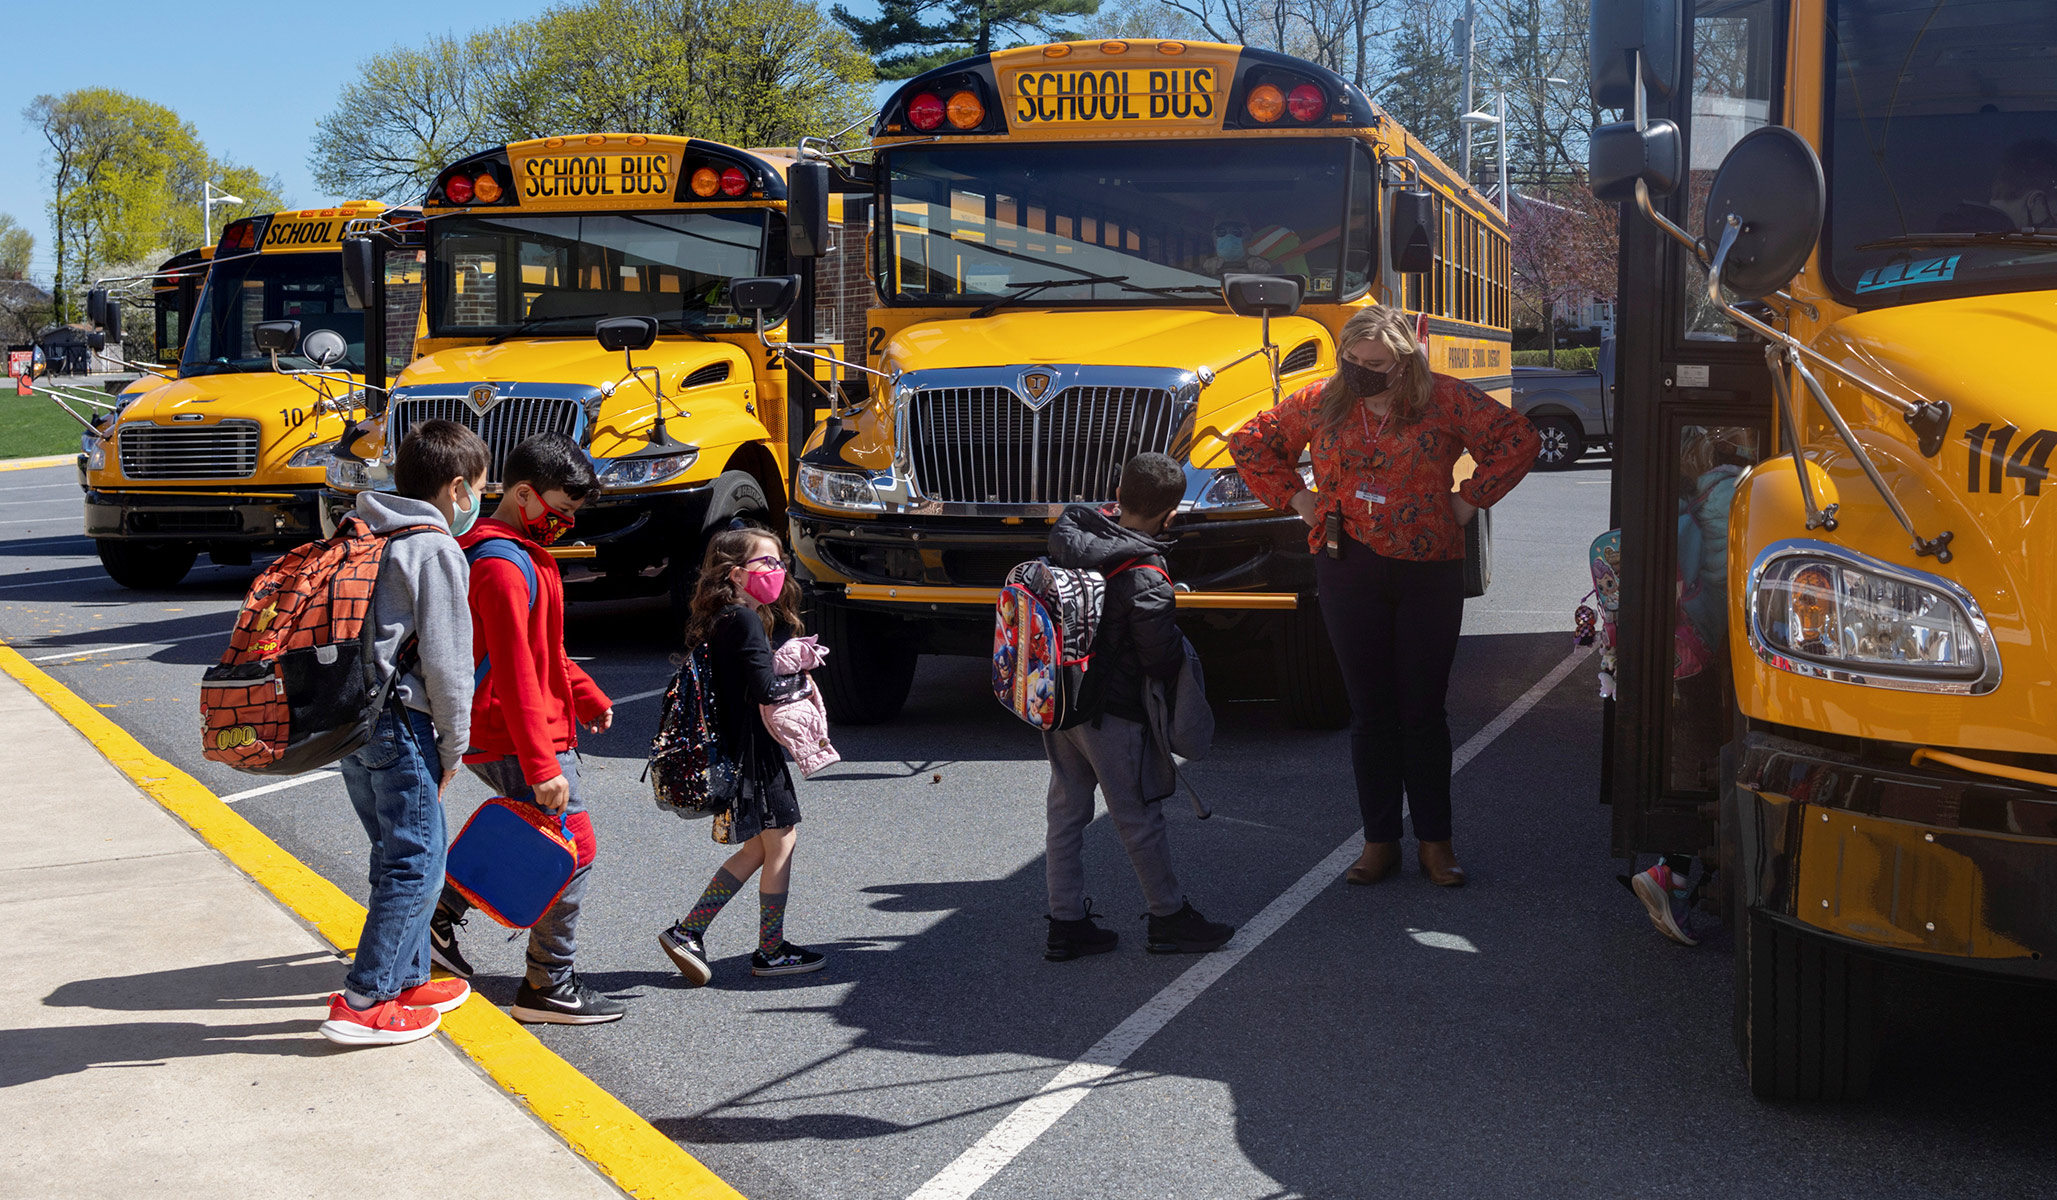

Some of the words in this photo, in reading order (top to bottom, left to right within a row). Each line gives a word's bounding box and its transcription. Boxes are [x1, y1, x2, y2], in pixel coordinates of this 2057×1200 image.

[1017, 71, 1140, 122] SCHOOL
[1149, 69, 1213, 118] BUS
[526, 156, 614, 197] SCHOOL
[621, 155, 668, 194] BUS
[266, 221, 333, 245] SCHOOL
[1860, 257, 1951, 289] 114
[280, 408, 303, 427] 10
[1964, 422, 2057, 496] 114
